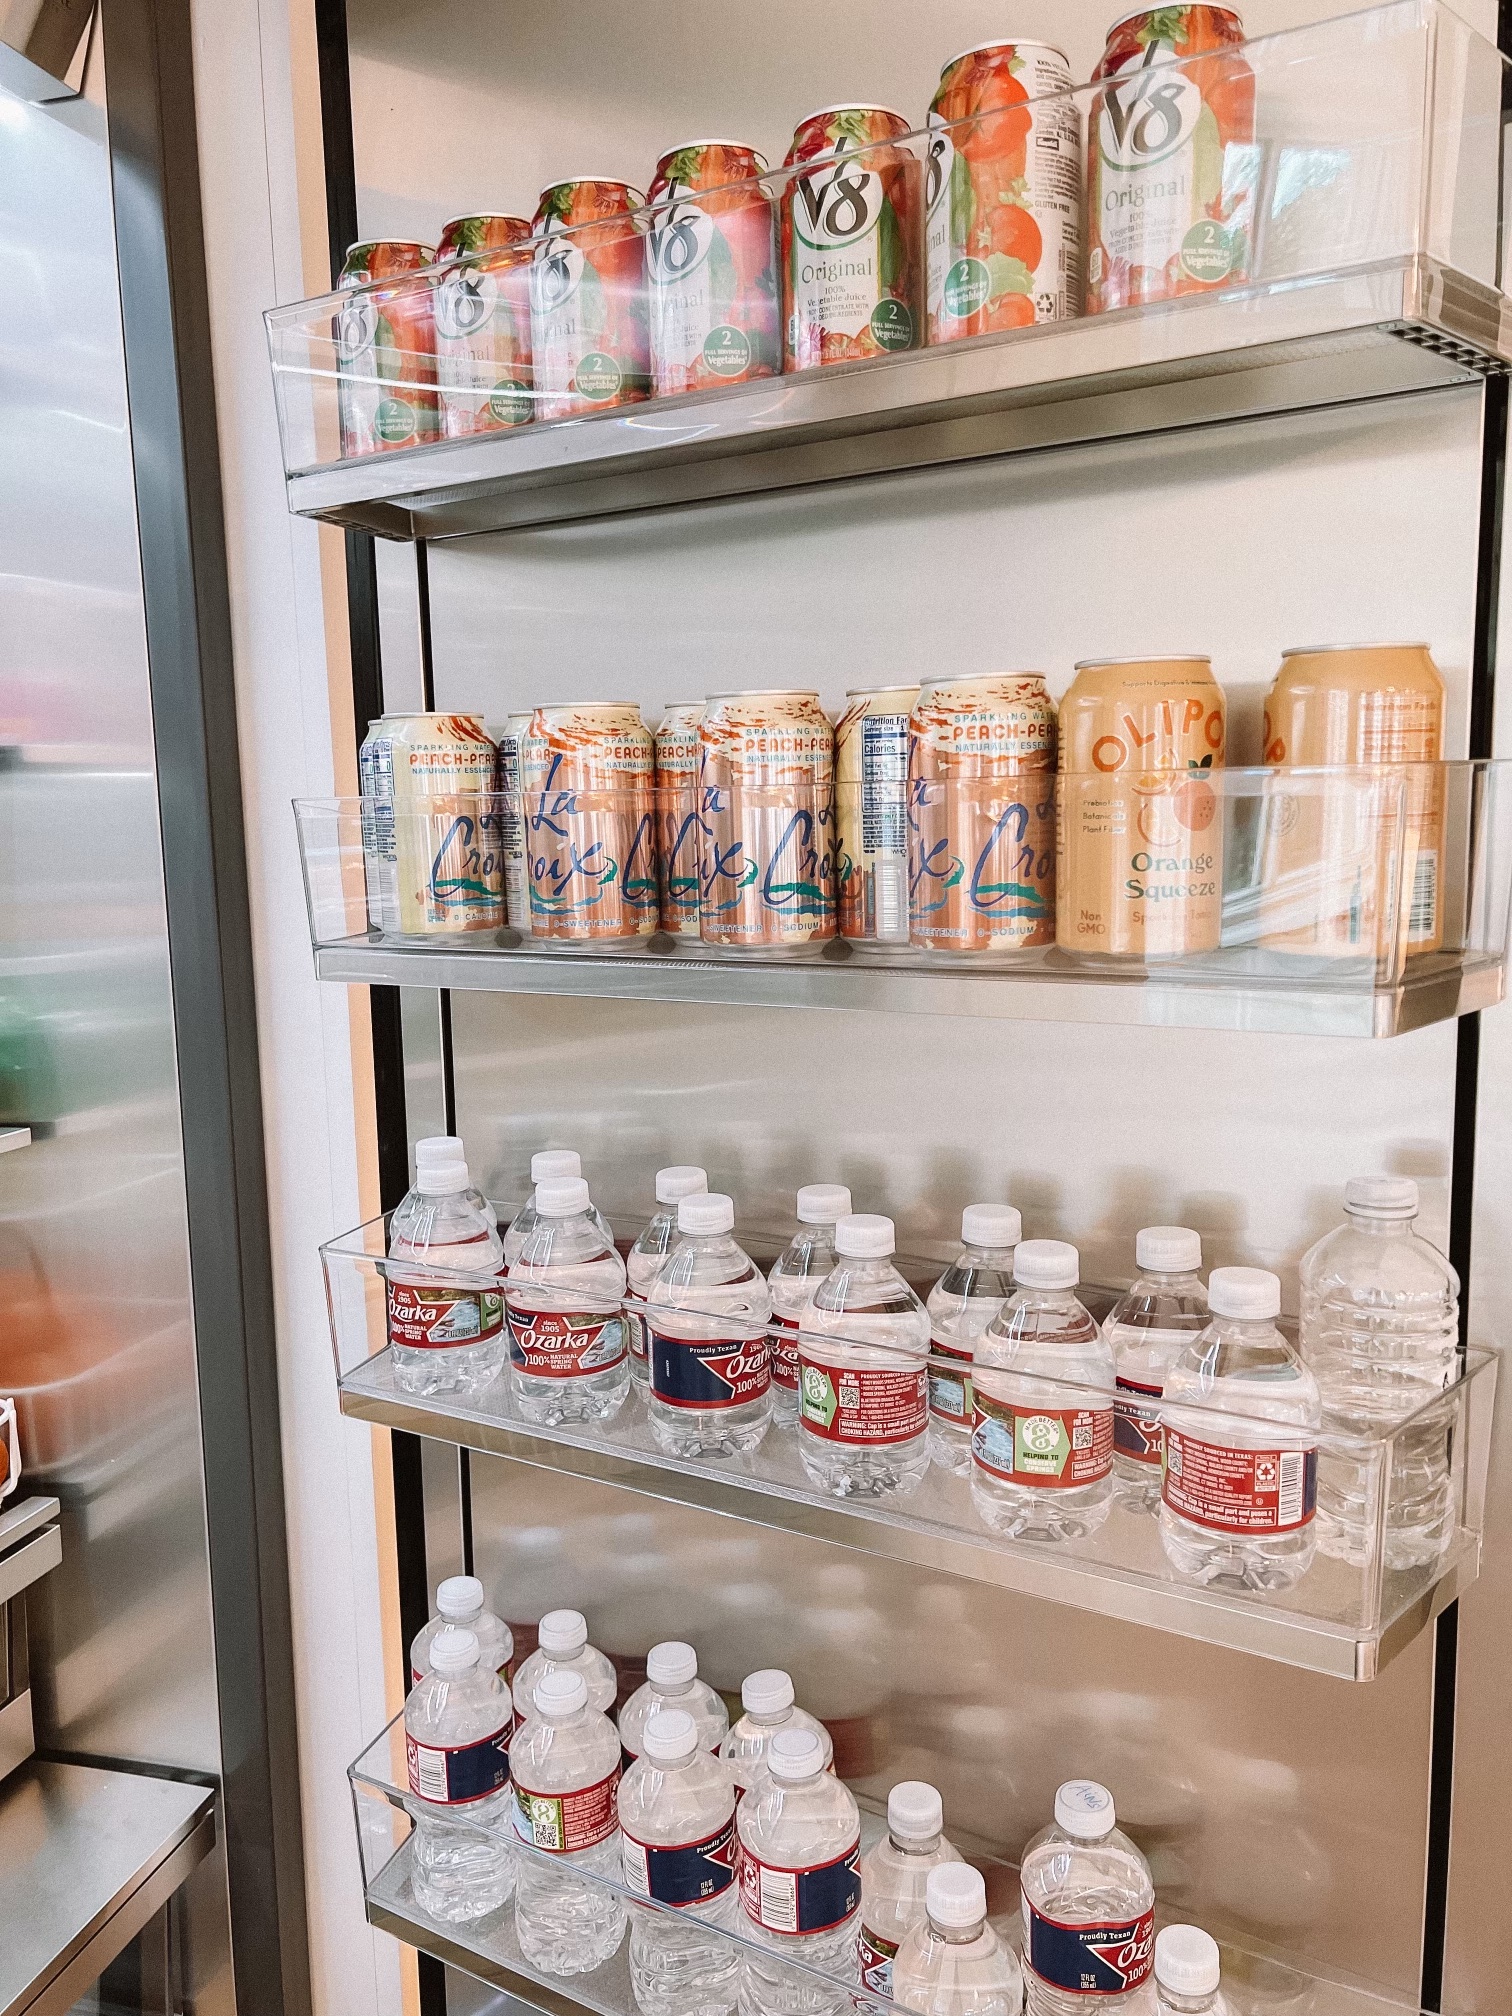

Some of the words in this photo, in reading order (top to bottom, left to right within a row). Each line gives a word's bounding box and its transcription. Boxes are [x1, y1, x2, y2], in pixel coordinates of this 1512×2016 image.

[1104, 40, 1187, 156] V8
[798, 136, 871, 238] V8
[1034, 200, 1058, 211] GLUTEN
[1058, 203, 1070, 214] FREE
[652, 176, 701, 273] V8
[1204, 226, 1215, 244] 2
[801, 257, 872, 284] Original
[960, 264, 970, 282] 2
[824, 286, 846, 295] 100%
[807, 294, 842, 307] Veetable
[844, 293, 867, 301] Juice
[889, 304, 898, 320] 2
[722, 330, 732, 346] 2
[874, 327, 910, 342] Vegetables
[593, 358, 602, 371] 2
[389, 403, 398, 416] 2
[954, 713, 1027, 723] SPARKLING
[746, 727, 810, 736] SPARKLING
[864, 725, 882, 733] Serving
[1091, 699, 1224, 772] OLIPO
[864, 743, 896, 753] Calories
[955, 742, 1016, 752] NATURALLY
[606, 761, 647, 769] NATURALLY
[658, 760, 693, 768] NATURALLY
[746, 754, 802, 763] NATURALLY
[530, 752, 582, 837] La
[969, 802, 1055, 908] Cro
[1131, 852, 1213, 874] Orange
[1124, 878, 1216, 903] Squeeze
[1080, 909, 1102, 922] Non
[1077, 923, 1106, 935] GMO
[397, 1295, 412, 1304] 1905
[388, 1298, 437, 1322] Ozarka
[541, 1325, 560, 1333] 1905
[520, 1329, 589, 1353] Ozarka
[689, 1347, 716, 1355] Proudly
[717, 1344, 738, 1352] Texan
[528, 1354, 551, 1366] 100%
[726, 1346, 771, 1379] Ozark
[736, 1377, 757, 1395] 100%
[1128, 1407, 1151, 1417] Texan
[841, 1421, 867, 1429] WARNING:
[867, 1422, 878, 1430] Cap
[1024, 1417, 1039, 1431] MADE
[1038, 1417, 1058, 1432] BETTER
[841, 1427, 863, 1436] CHOKING
[1023, 1451, 1049, 1460] HELPING
[1023, 1458, 1057, 1467] CONSERVE
[1026, 1464, 1055, 1473] SPRINGS
[1208, 1503, 1225, 1513] small
[1224, 1508, 1238, 1517] part
[1238, 1509, 1250, 1517] and
[1250, 1510, 1268, 1518] poses
[1204, 1511, 1238, 1524] particularly
[1238, 1516, 1248, 1524] for
[1248, 1517, 1274, 1525] children.
[697, 1839, 720, 1854] Proudly
[1078, 1932, 1107, 1942] Proudly
[1108, 1931, 1131, 1940] Texan
[1080, 1973, 1086, 1981] 12
[1090, 1973, 1096, 1981] OZ
[1127, 1961, 1149, 1983] 100%
[1080, 1981, 1090, 1989] (355
